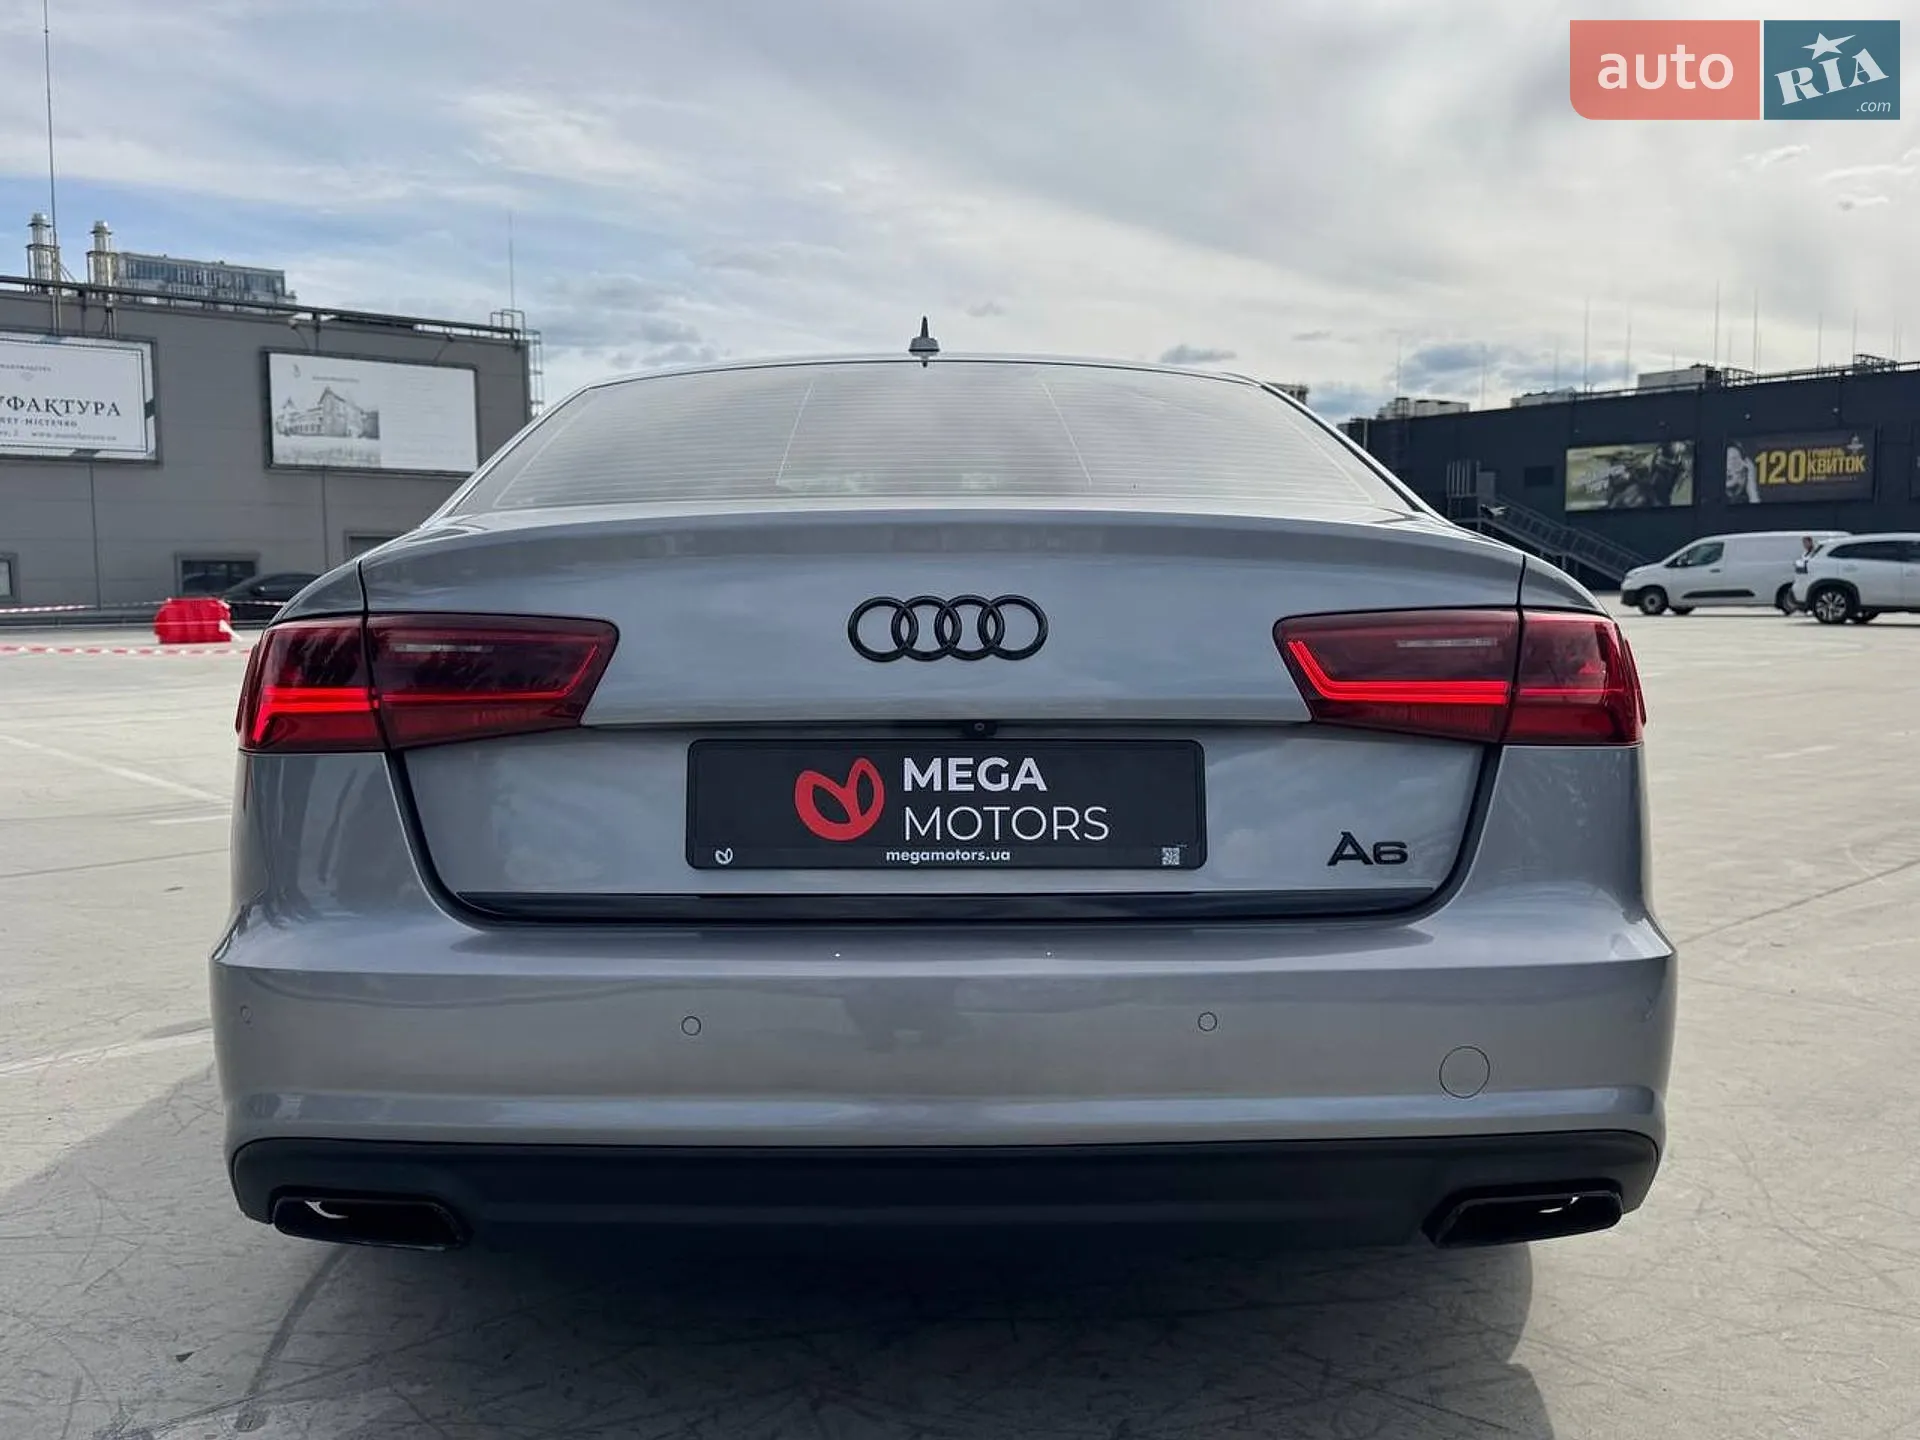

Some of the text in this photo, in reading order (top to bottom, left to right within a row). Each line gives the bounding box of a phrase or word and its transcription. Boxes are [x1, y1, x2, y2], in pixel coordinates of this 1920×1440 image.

[1755, 449, 1807, 485] 120
[1807, 454, 1866, 474] КВИТОК
[902, 757, 1048, 792] MEGA
[904, 806, 1110, 842] MOTORS
[886, 849, 1011, 865] megamotors.ua
[1326, 831, 1409, 867] A6
